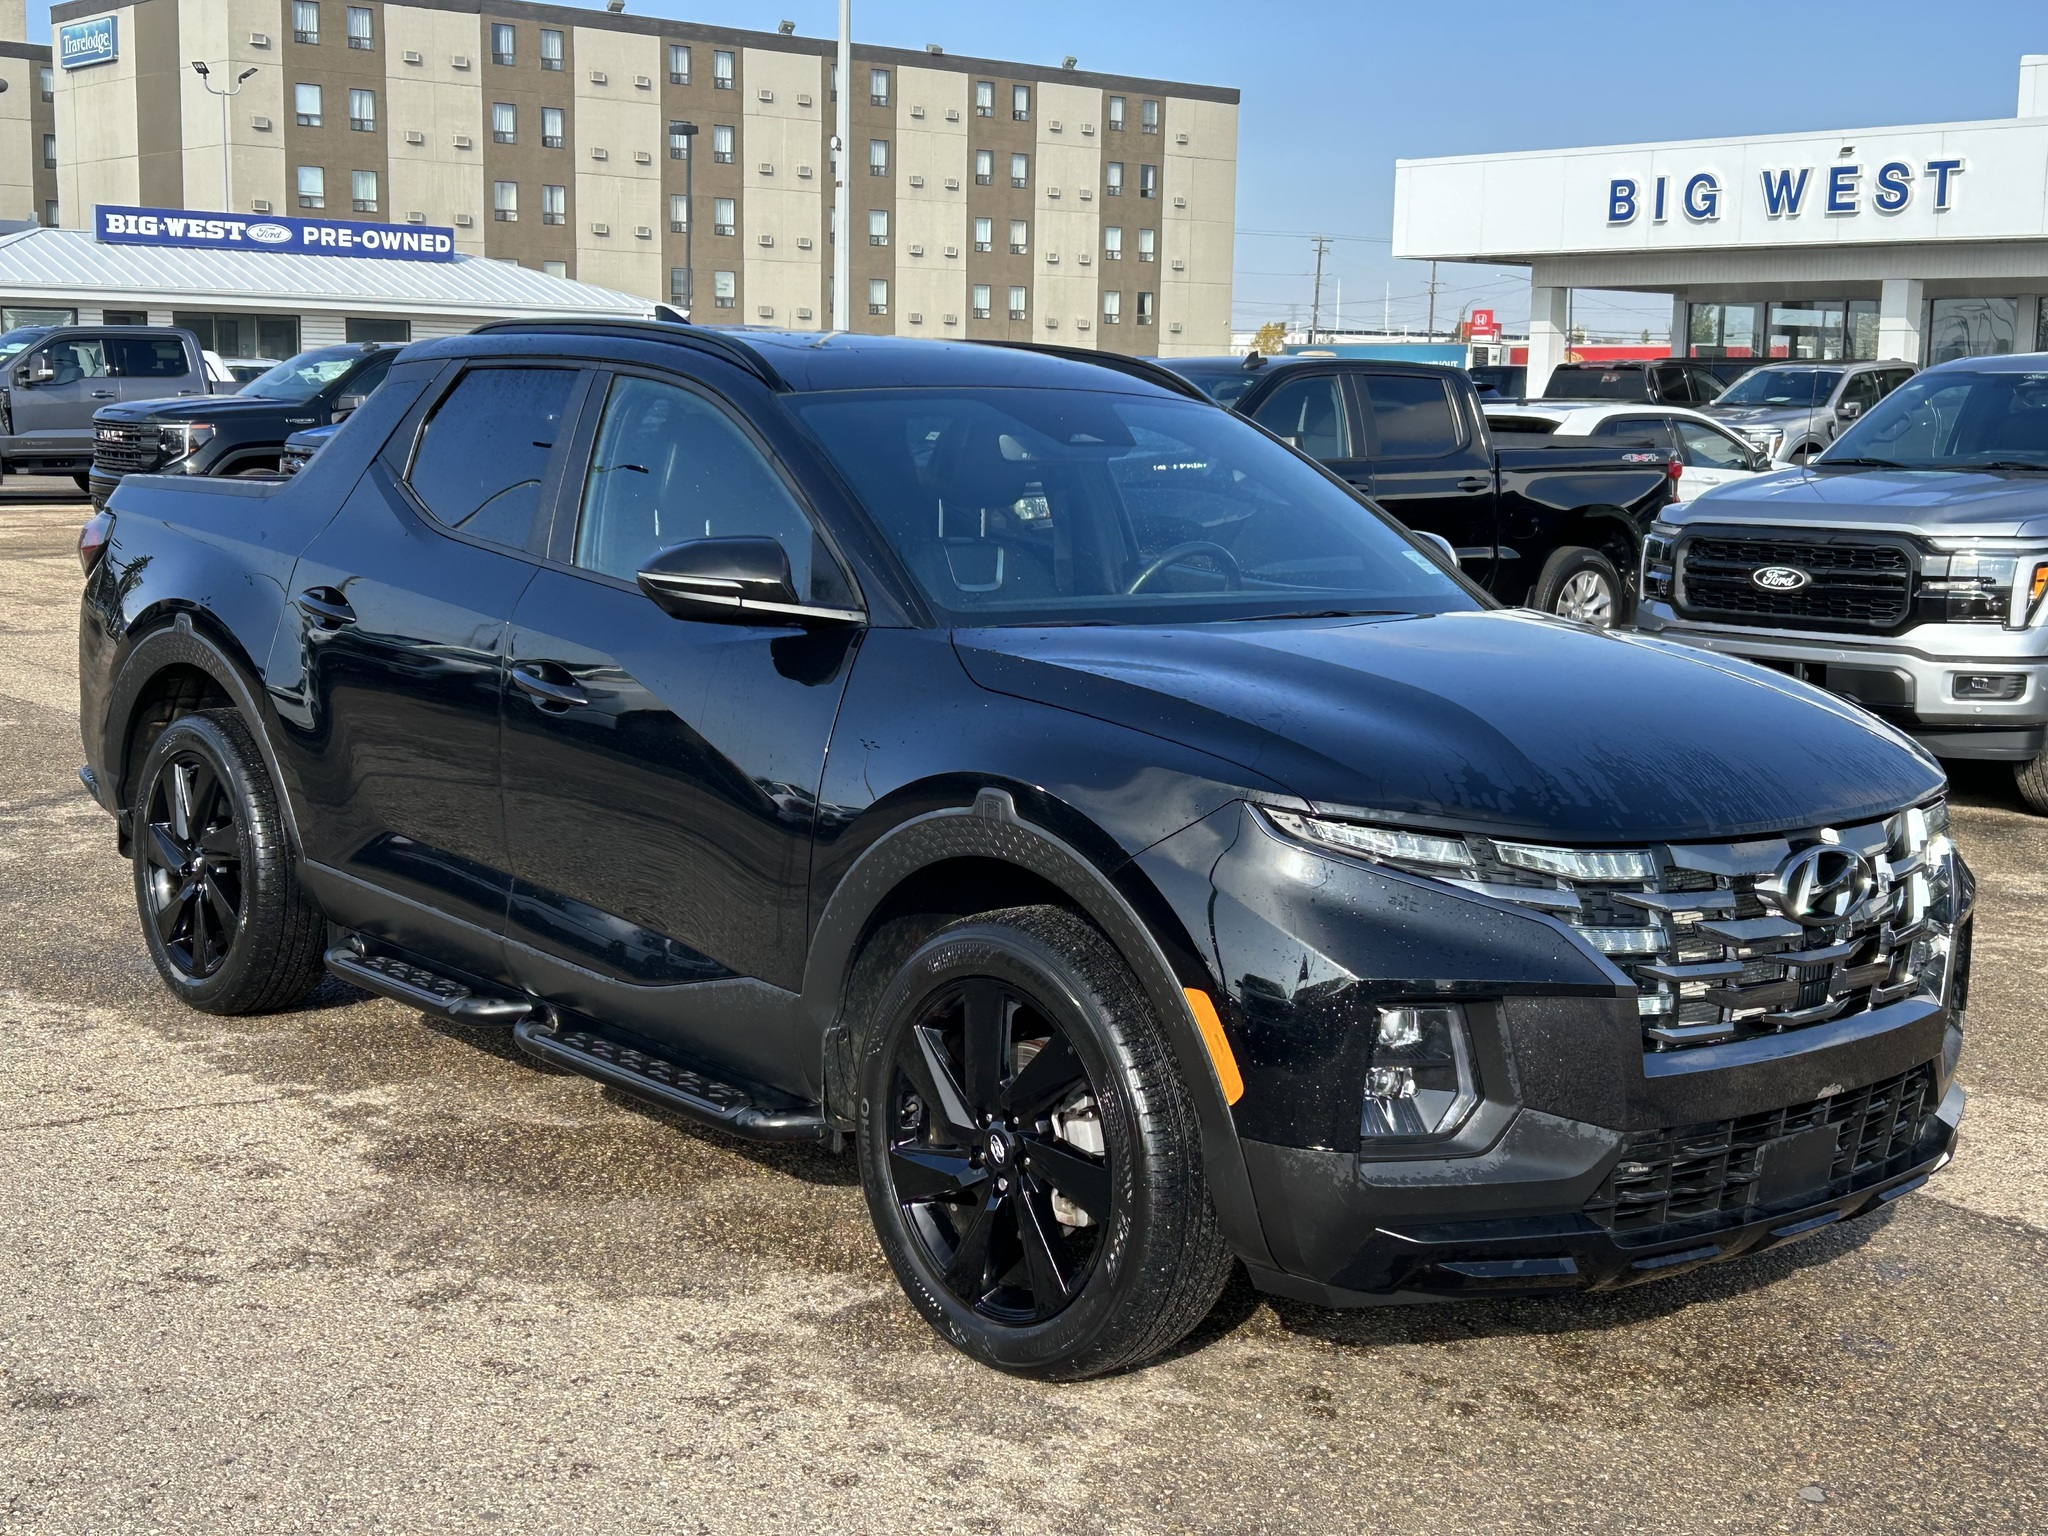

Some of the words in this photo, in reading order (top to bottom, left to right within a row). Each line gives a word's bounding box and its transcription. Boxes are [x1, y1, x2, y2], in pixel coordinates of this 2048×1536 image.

[63, 28, 110, 54] Travelodge
[1607, 172, 1721, 224] BIG
[1760, 159, 1964, 220] WEST
[105, 213, 158, 236] BIG
[163, 217, 246, 241] WEST
[303, 226, 451, 253] PRE-OWNED
[1762, 569, 1796, 586] Ford
